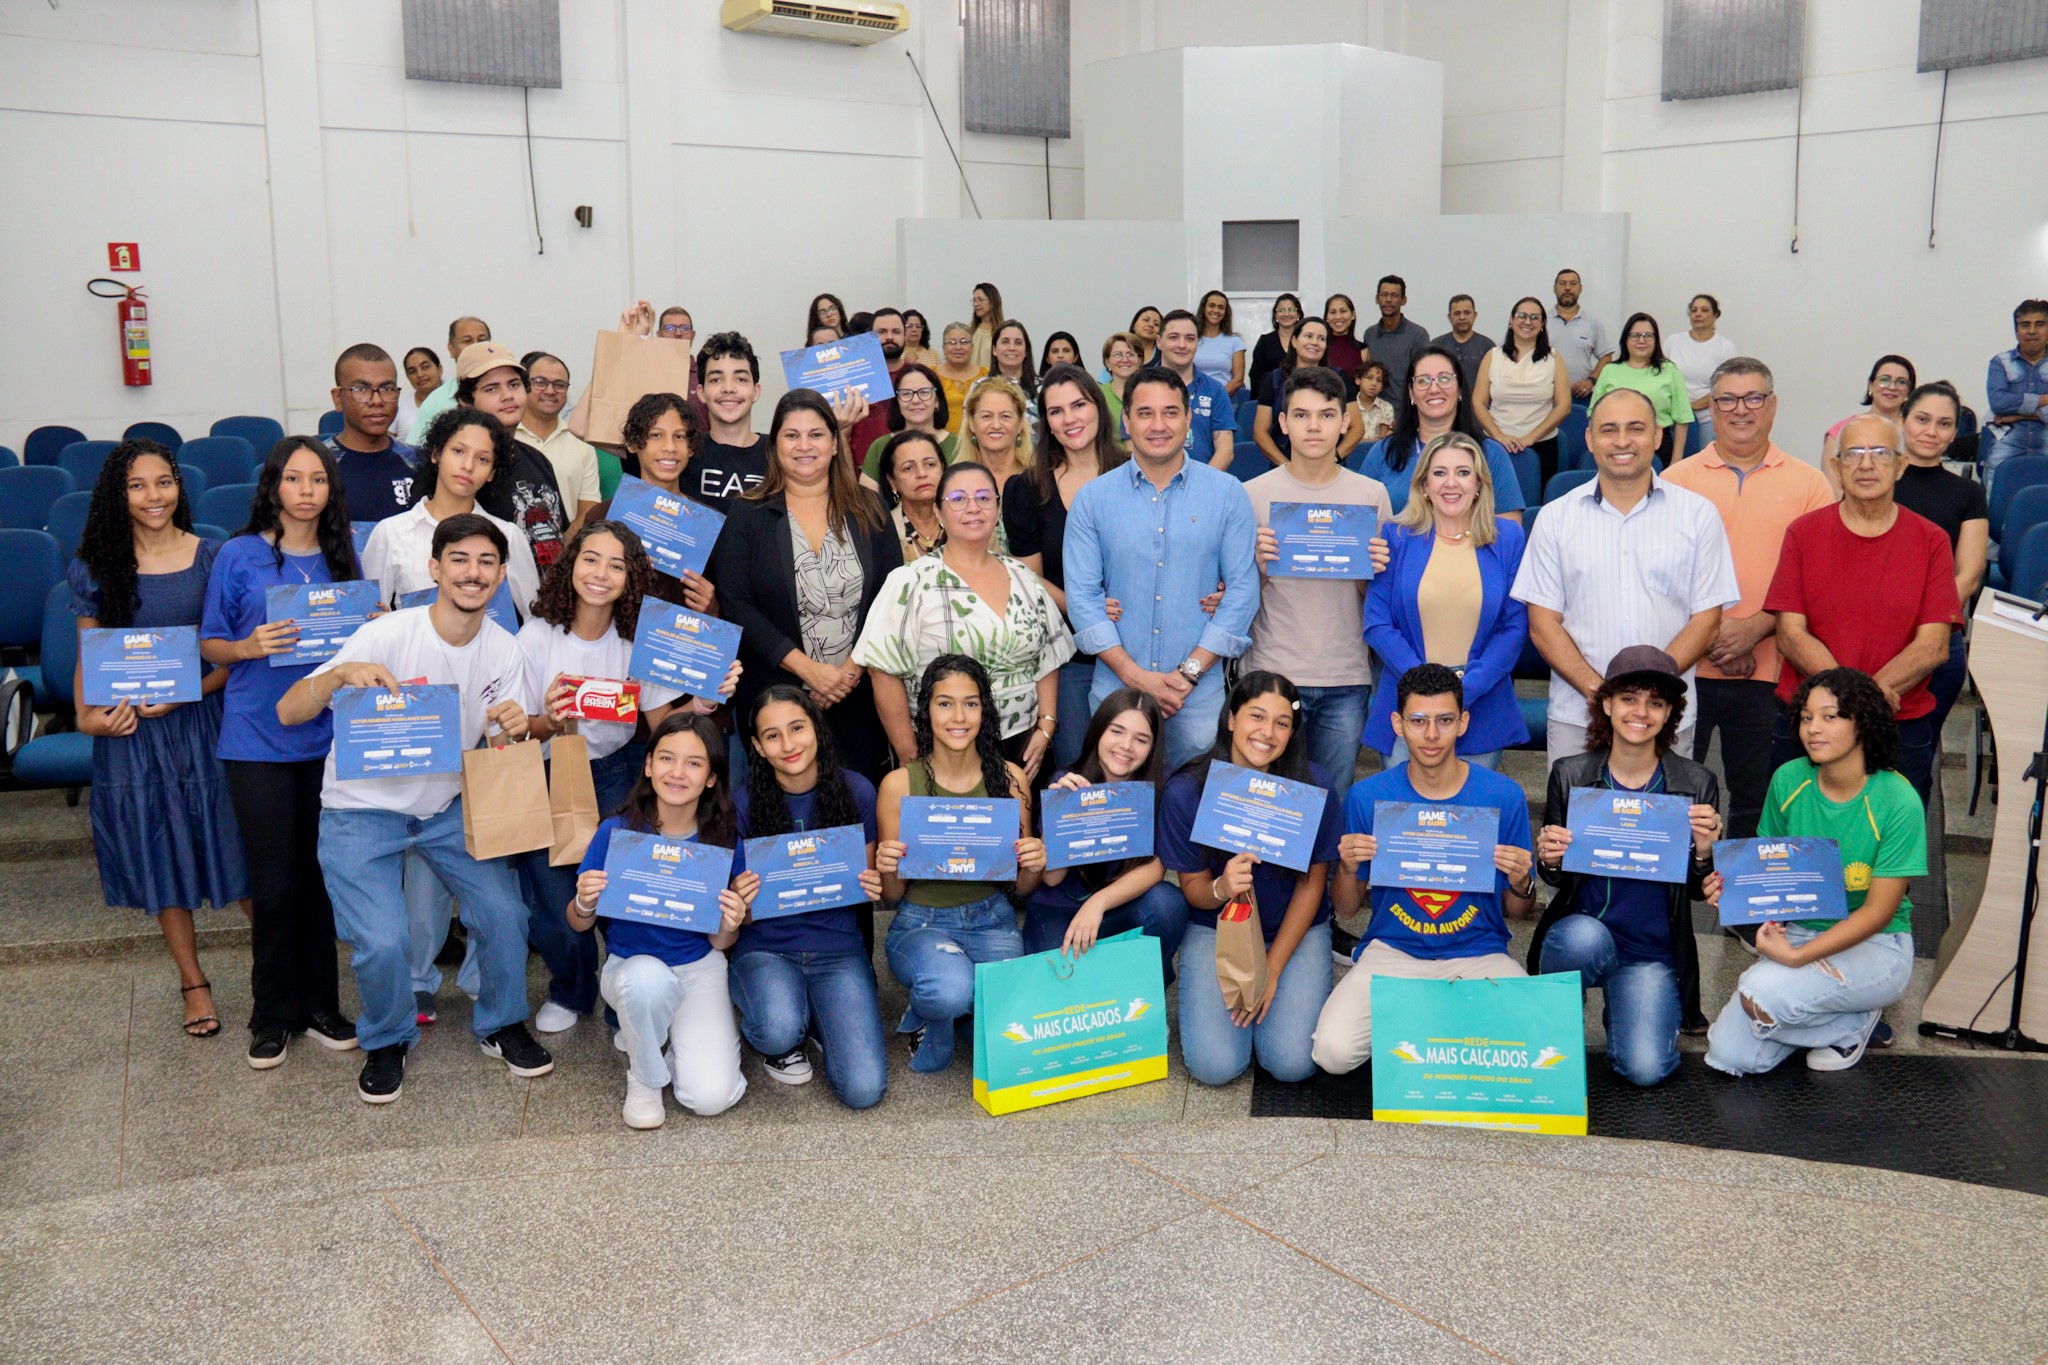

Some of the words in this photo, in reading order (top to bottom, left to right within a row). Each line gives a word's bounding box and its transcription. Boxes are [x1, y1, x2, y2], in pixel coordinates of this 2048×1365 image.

[816, 347, 838, 358] GAME
[656, 495, 680, 510] GAME
[308, 589, 334, 600] GAME
[676, 614, 700, 627] GAME
[124, 634, 151, 643] GAME
[376, 693, 404, 705] GAME
[1250, 778, 1276, 791] GAME
[1081, 790, 1105, 801] GAME
[1613, 798, 1640, 808] GAME
[1418, 811, 1445, 820] GAME
[653, 844, 681, 856] GAME
[788, 838, 815, 851] GAME
[1758, 843, 1786, 854] GAME
[949, 864, 975, 873] GAME
[1389, 902, 1422, 934] ESCOLA
[1423, 922, 1438, 934] DA
[1439, 904, 1480, 934] AUTORIA
[1064, 1004, 1086, 1015] REDE
[1034, 1020, 1062, 1040] MAIS
[1063, 1007, 1122, 1033] CALÇADOS
[1106, 1032, 1126, 1040] BRASIL
[1464, 1037, 1489, 1047] REDE
[1426, 1047, 1458, 1064] MAIS
[1460, 1048, 1528, 1069] CALÇADOS
